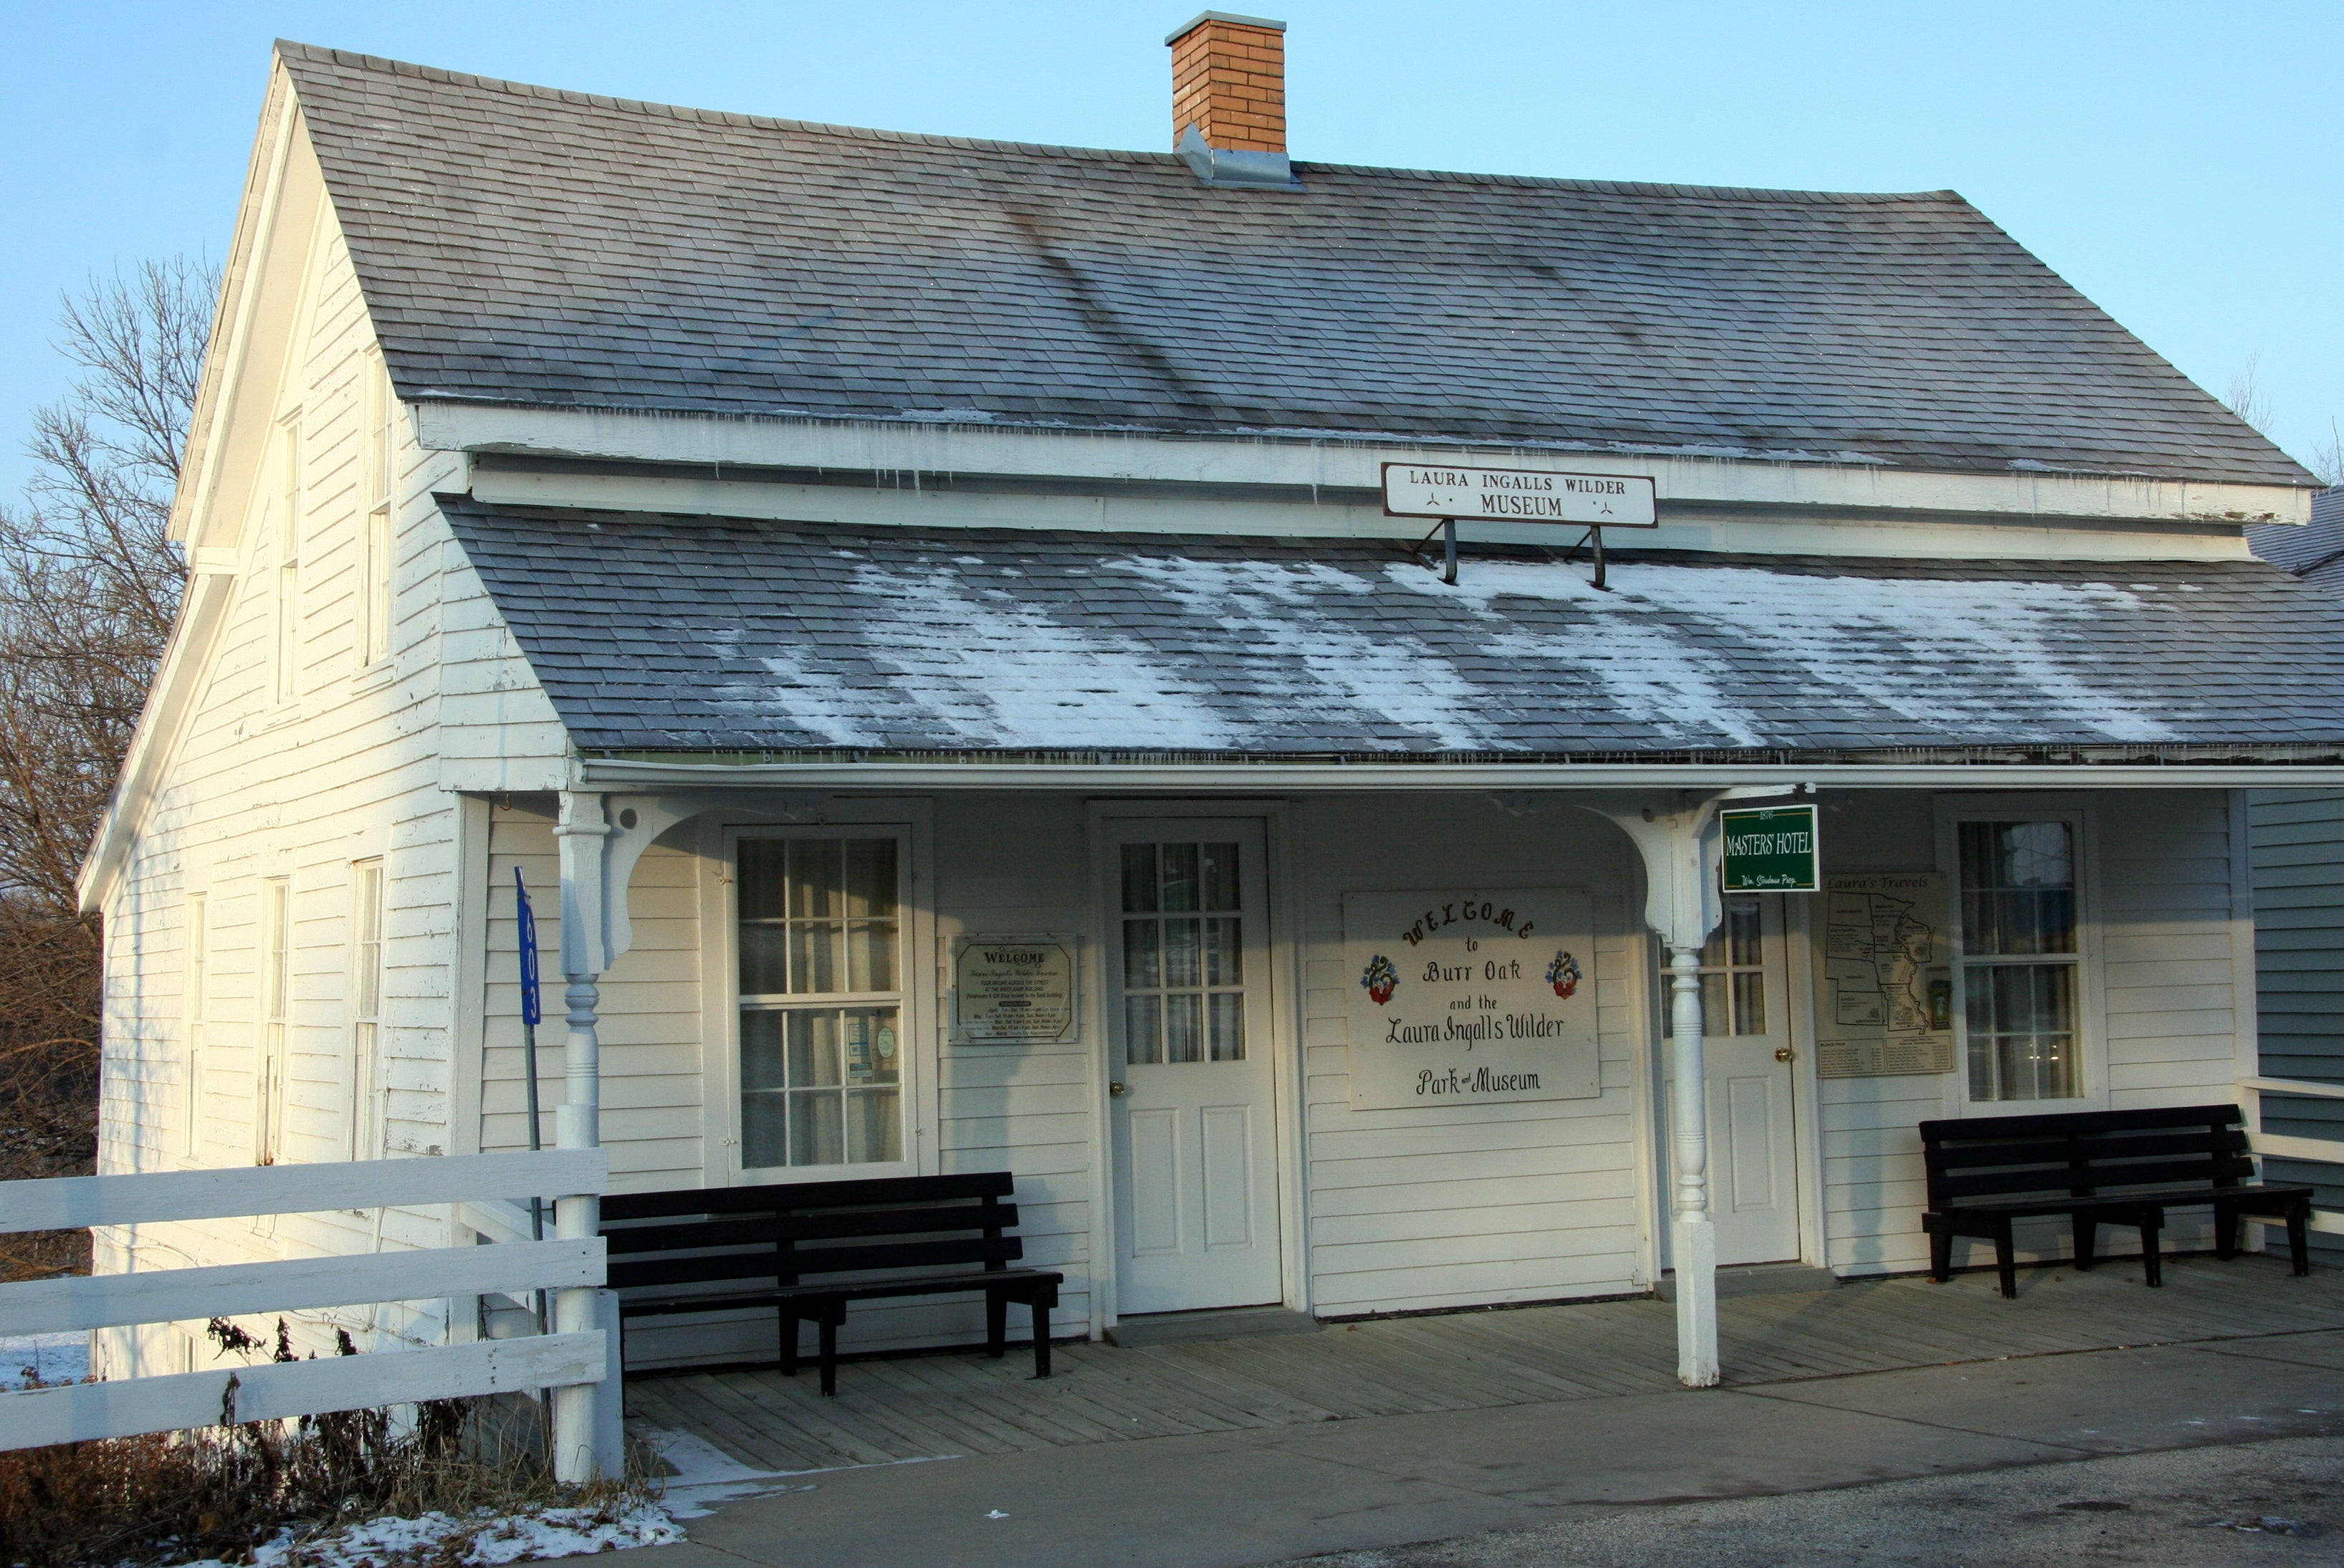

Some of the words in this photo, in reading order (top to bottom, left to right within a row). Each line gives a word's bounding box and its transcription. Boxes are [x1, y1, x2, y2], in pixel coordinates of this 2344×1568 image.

[1410, 470, 1469, 487] LAURA
[1483, 474, 1552, 491] INGALLS
[1565, 479, 1626, 494] WILDER
[1480, 494, 1563, 516] MUSEUM
[1759, 811, 1774, 821] 1876
[1726, 833, 1775, 856] MASTERS'
[1776, 831, 1812, 854] HOTEL
[1826, 876, 1875, 890] Laura's
[1881, 875, 1929, 889] Travels
[1402, 900, 1534, 947] WELCOME
[1465, 937, 1478, 952] to
[984, 952, 1045, 964] WELCOME
[1422, 961, 1473, 983] Burr
[1485, 958, 1522, 981] Oak
[1449, 995, 1471, 1010] and
[1478, 994, 1497, 1010] the
[1385, 1017, 1440, 1044] Laura
[1444, 1015, 1503, 1052] Ingalls
[1506, 1013, 1565, 1038] Wilder
[1416, 1068, 1460, 1096] Park
[1471, 1066, 1541, 1093] Museum
